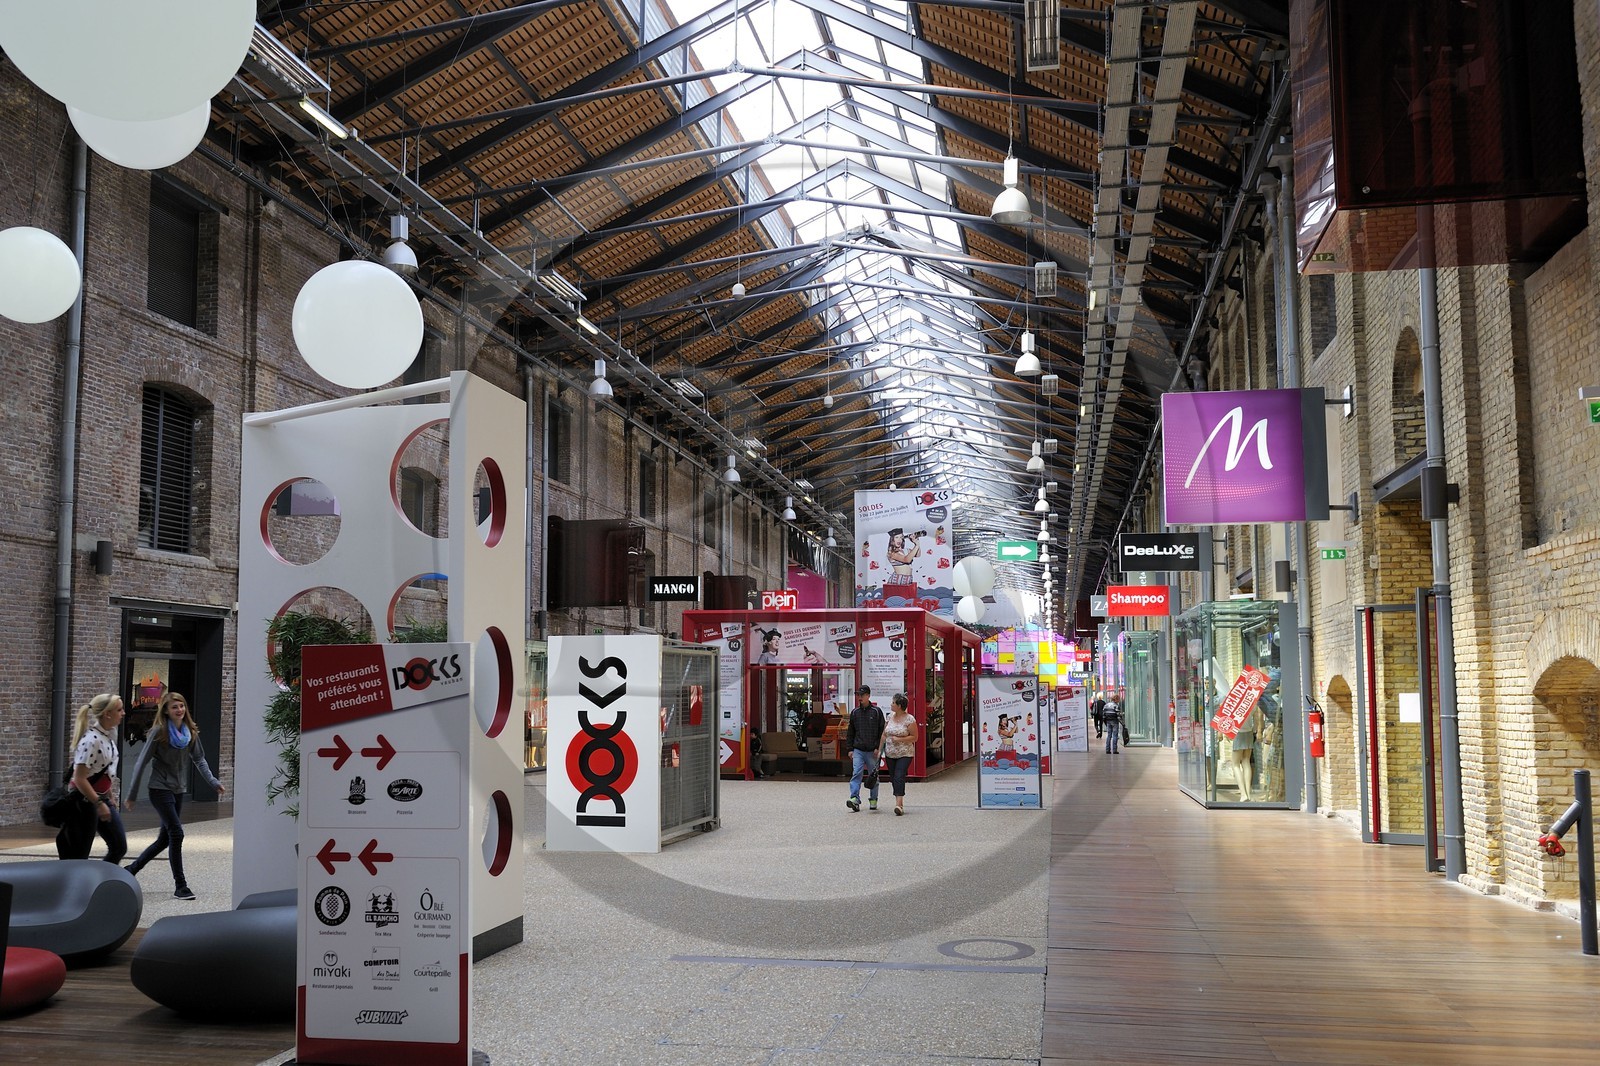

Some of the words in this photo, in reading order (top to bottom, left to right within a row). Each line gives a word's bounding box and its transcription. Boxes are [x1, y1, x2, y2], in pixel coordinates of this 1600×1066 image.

[915, 490, 949, 505] DOCKS
[858, 503, 884, 513] SOLDES
[1124, 545, 1194, 556] DeeLuXe
[654, 584, 695, 594] MANGO
[1094, 601, 1108, 611] ZA
[1111, 593, 1165, 606] Shampoo
[307, 678, 324, 688] Vos
[326, 664, 380, 684] restaurants
[392, 654, 461, 691] DOCKS
[318, 682, 357, 702] préférés
[359, 678, 382, 690] vous
[1012, 680, 1033, 690] DOCKS
[330, 692, 378, 711] attendent
[380, 690, 384, 700] !
[1222, 681, 1249, 717] DEELUXE
[1236, 692, 1256, 718] SOLDES
[576, 656, 628, 827] DOCKS
[414, 912, 451, 921] GOURMAND
[364, 959, 399, 967] COMPTOIR
[414, 969, 452, 978] Courtepaille
[355, 1010, 409, 1024] SUBWAY
